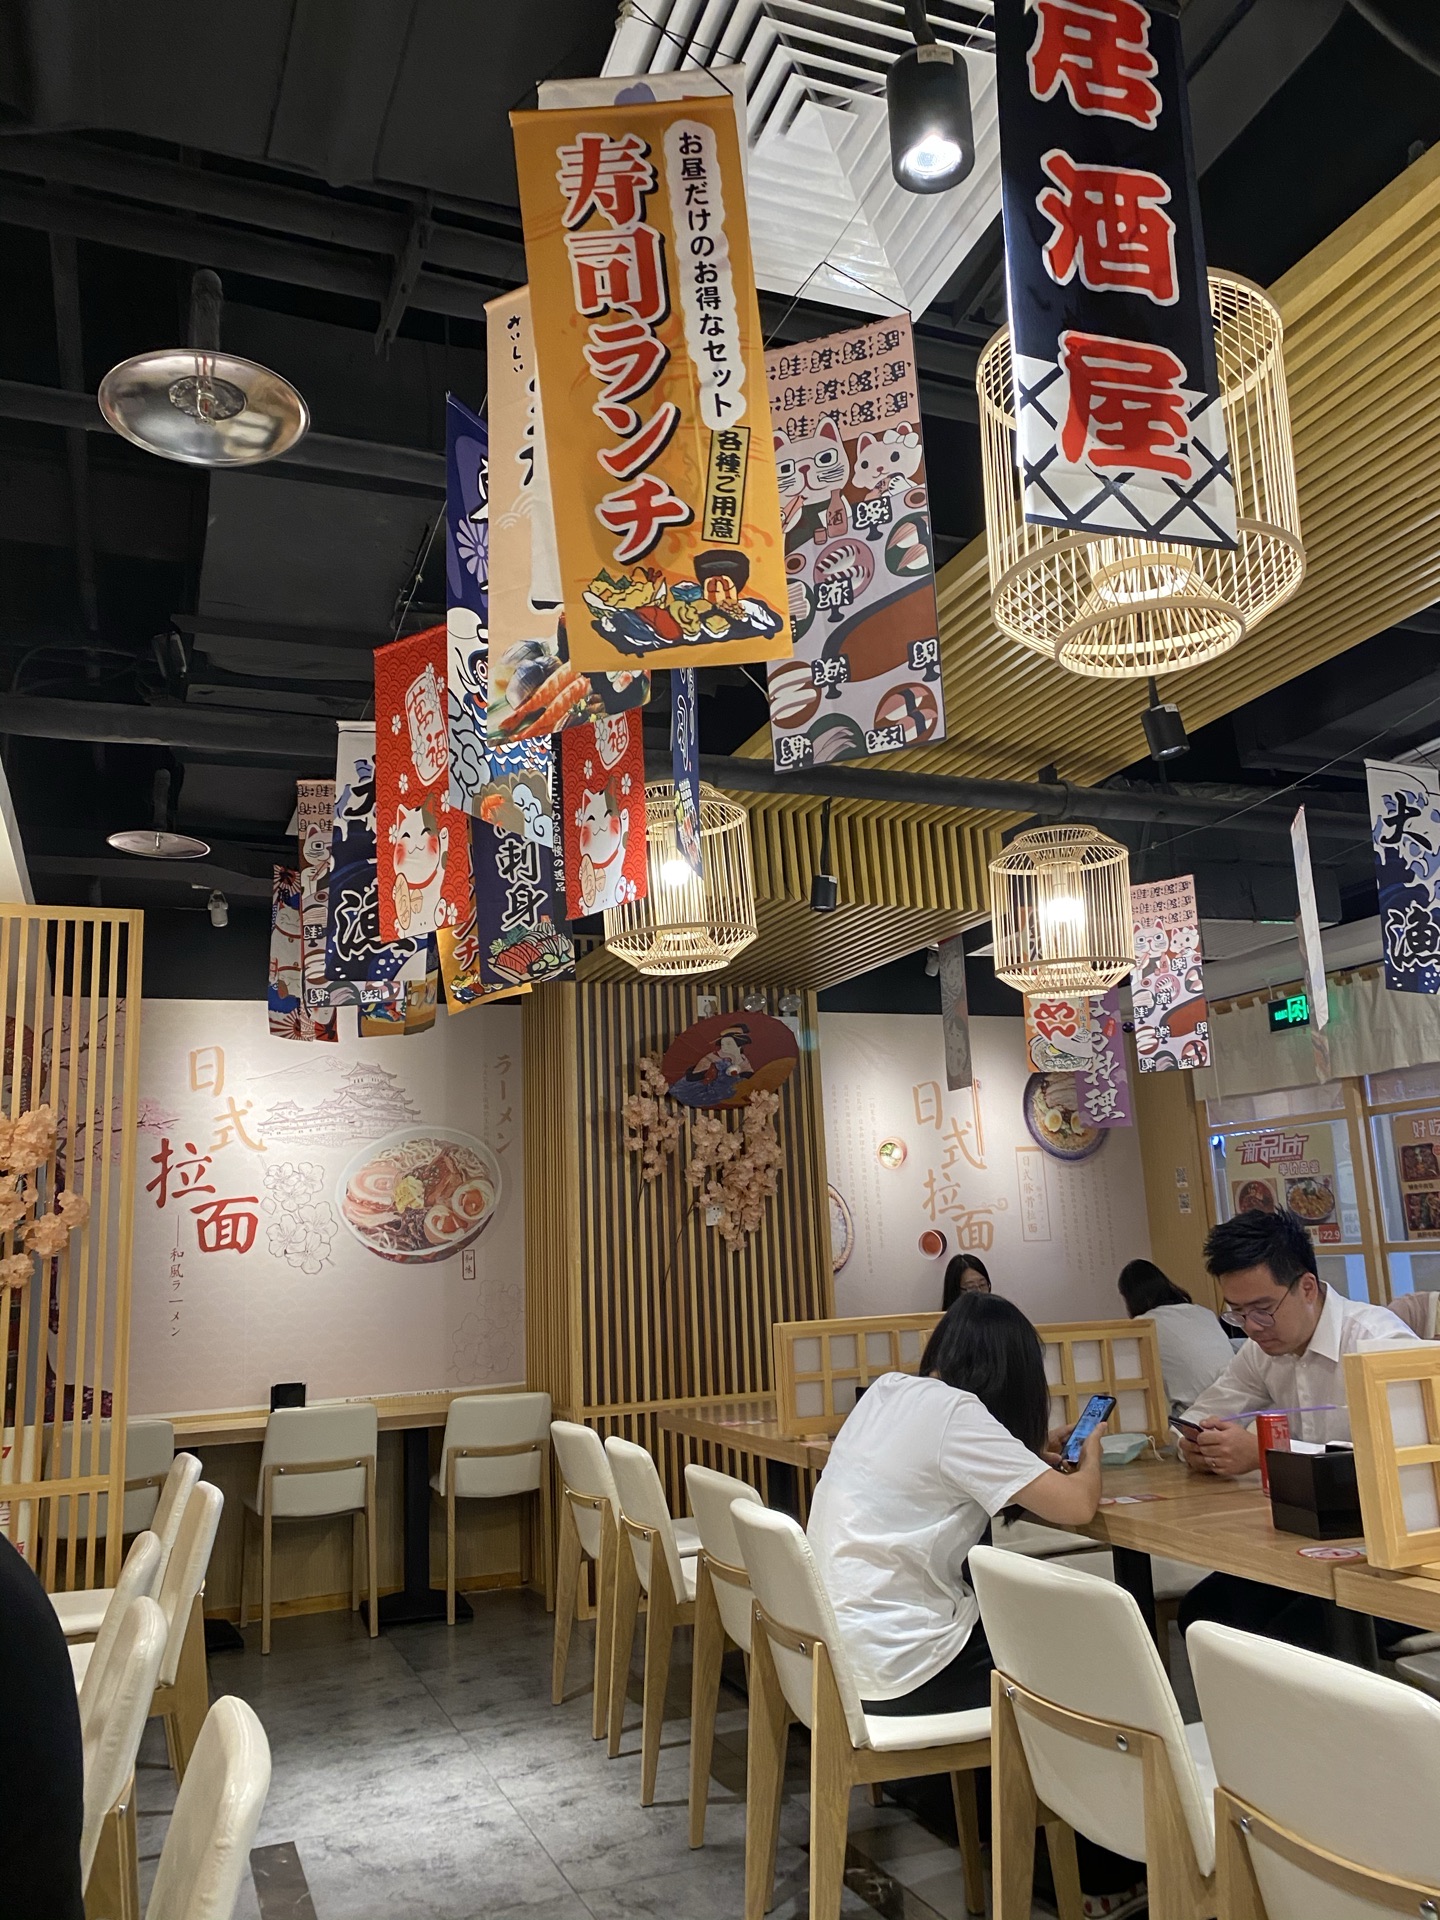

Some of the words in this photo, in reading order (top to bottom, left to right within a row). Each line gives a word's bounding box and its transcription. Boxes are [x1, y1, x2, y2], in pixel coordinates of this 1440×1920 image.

[678, 131, 732, 420] お昼だけのお得なセット
[1026, 0, 1193, 481] 居酒屋
[556, 131, 694, 566] 寿司ランチ
[707, 431, 744, 540] 各種ご用意
[607, 715, 628, 753] 福
[146, 1045, 268, 1255] 日式拉面
[493, 1053, 513, 1154] ラーメン
[911, 1080, 994, 1252] 日式拉面
[1236, 1133, 1309, 1168] 新品上市
[168, 1247, 184, 1337] 和風ラーメン
